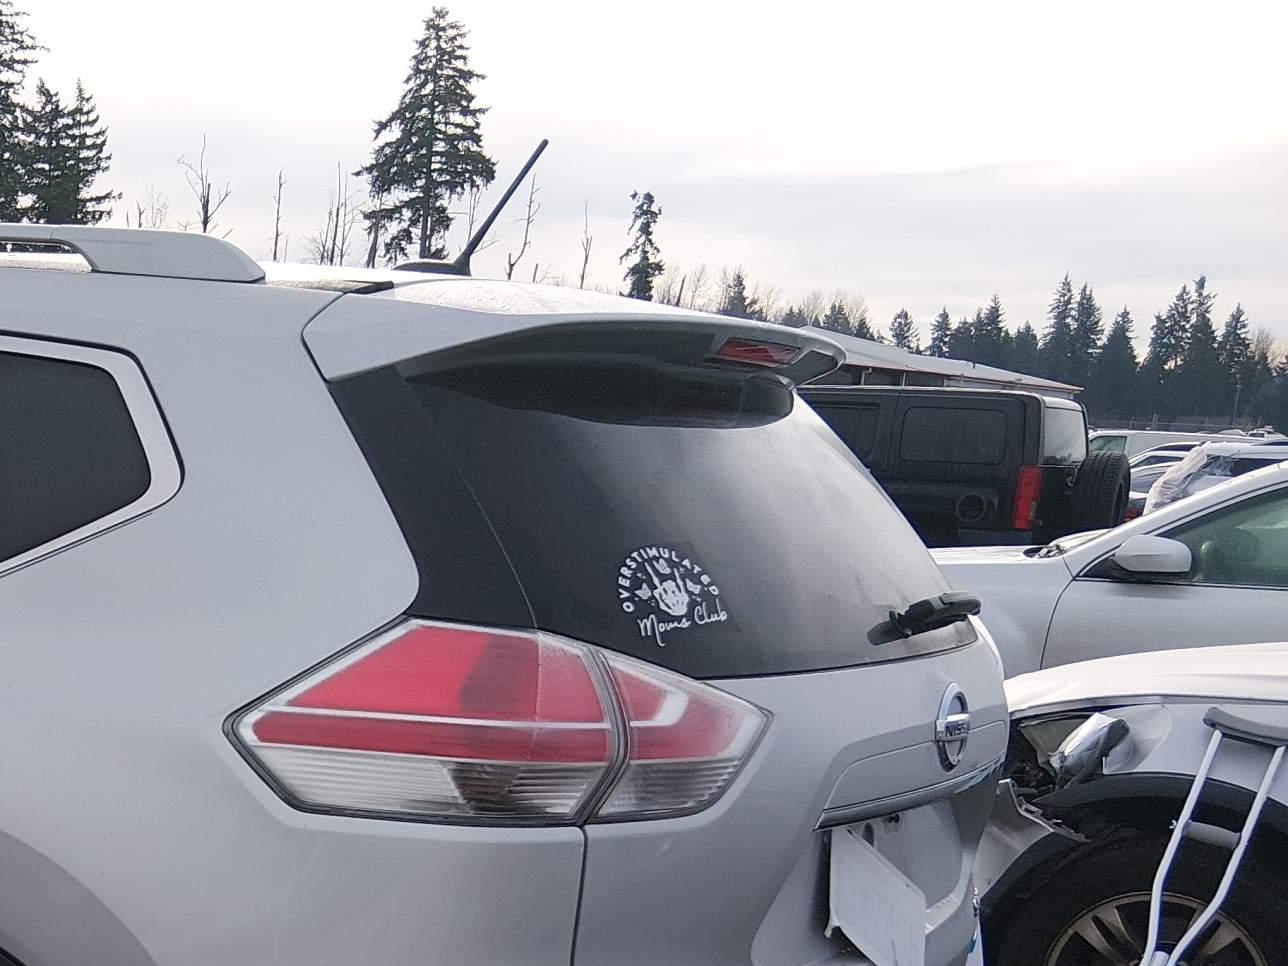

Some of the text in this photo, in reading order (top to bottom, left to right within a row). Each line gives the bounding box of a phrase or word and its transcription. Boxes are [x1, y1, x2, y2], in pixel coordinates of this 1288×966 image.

[618, 546, 720, 613] OVERSTIMULATED
[636, 598, 728, 647] Moms Club
